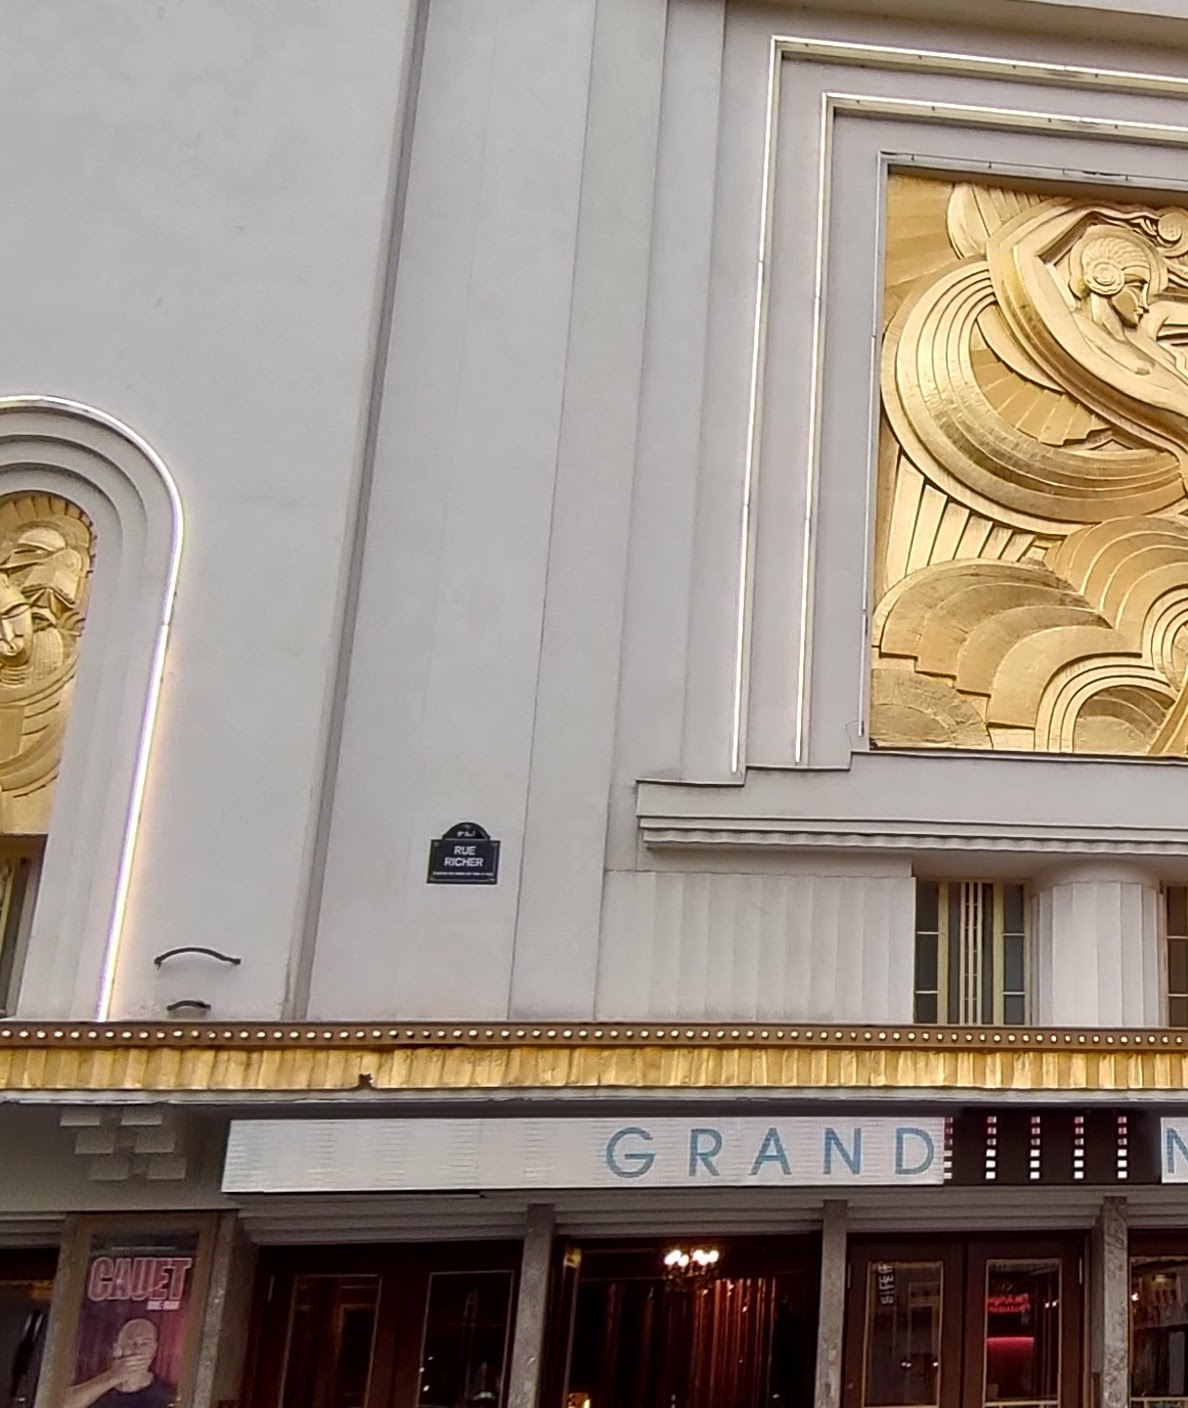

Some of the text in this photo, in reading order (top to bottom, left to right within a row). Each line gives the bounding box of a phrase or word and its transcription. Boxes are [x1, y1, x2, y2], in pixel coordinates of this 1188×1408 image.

[444, 857, 484, 867] RICHER
[453, 845, 477, 856] RUE
[605, 1126, 935, 1180] GRAND
[88, 1256, 193, 1302] CAUET
